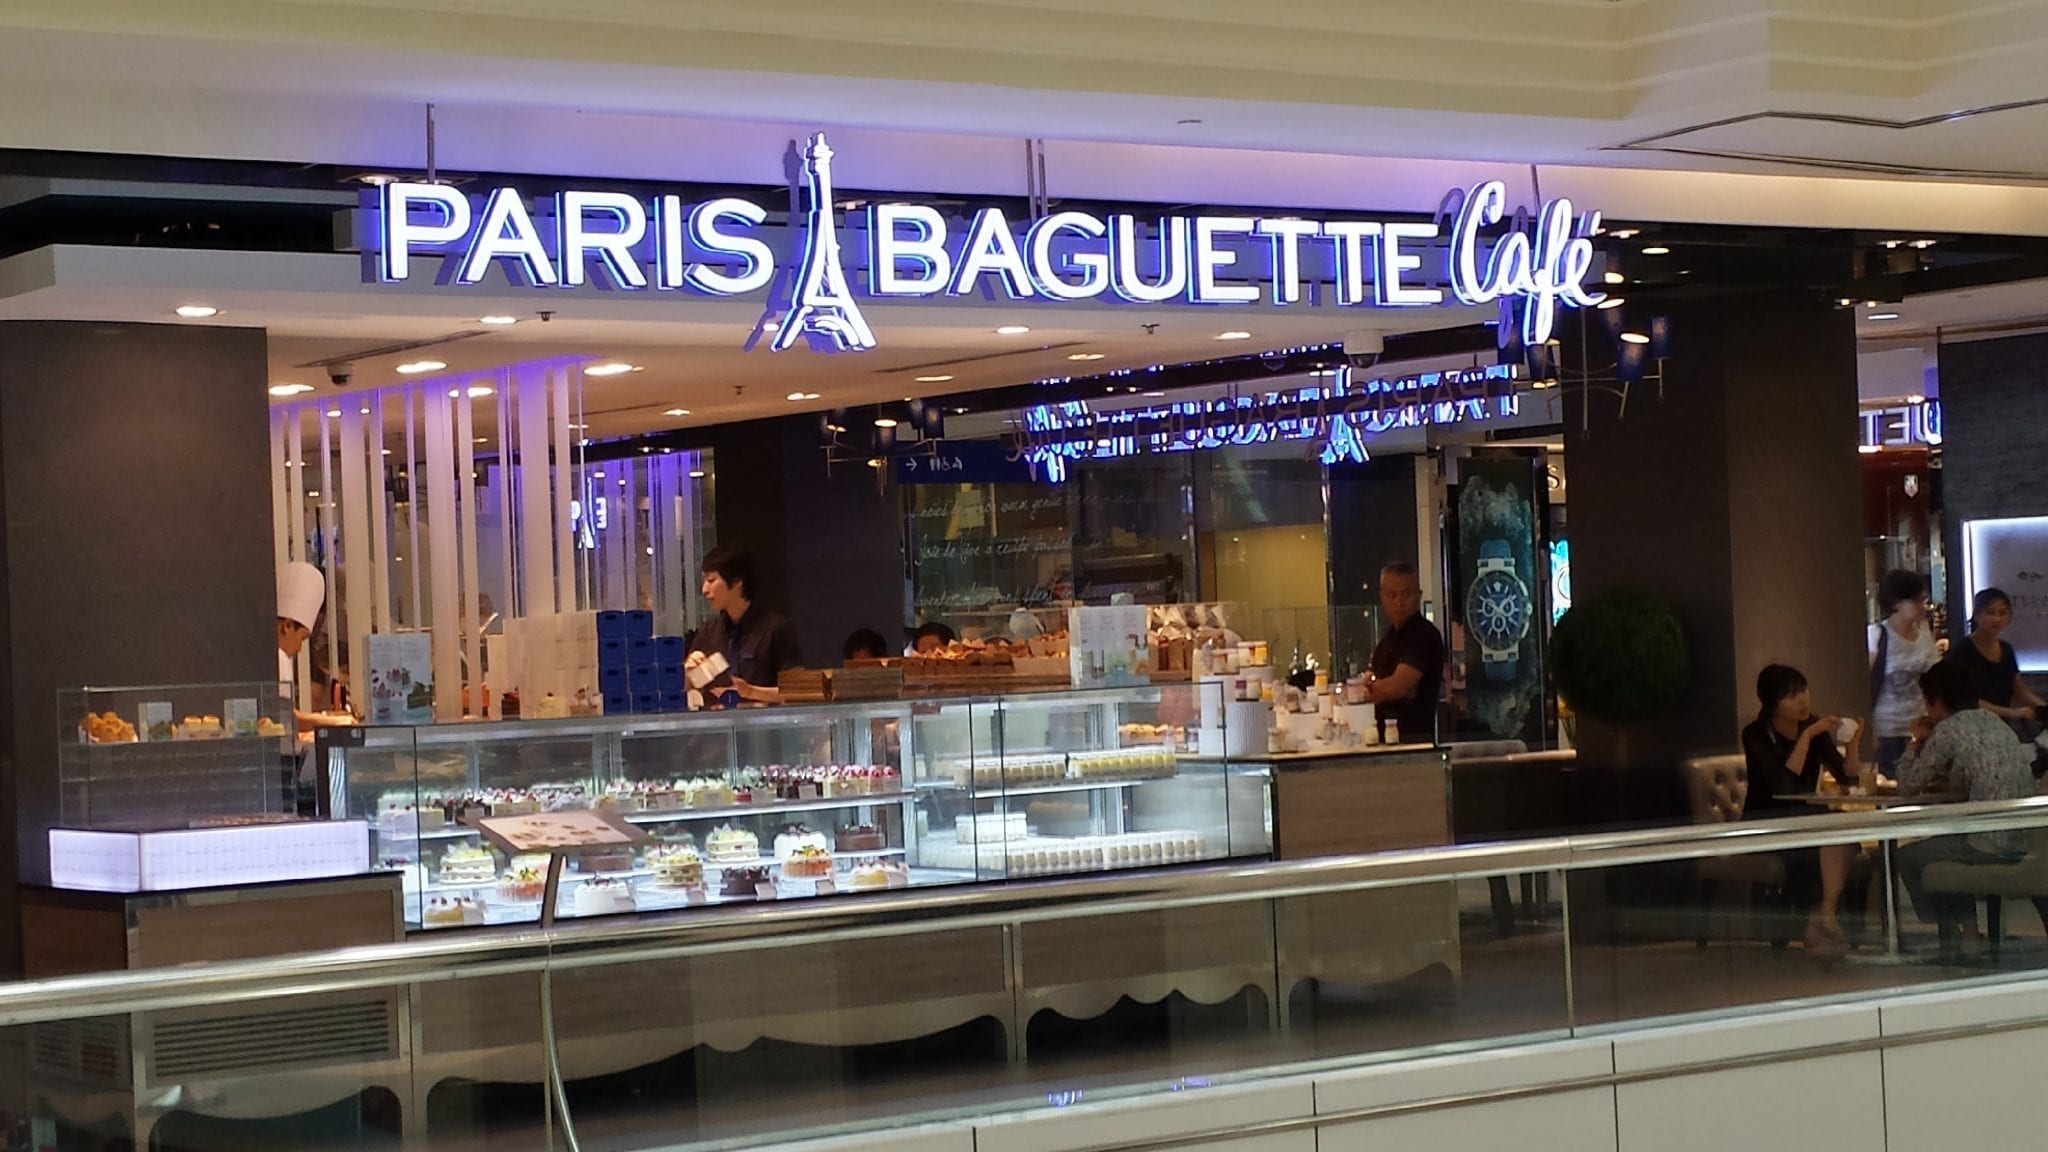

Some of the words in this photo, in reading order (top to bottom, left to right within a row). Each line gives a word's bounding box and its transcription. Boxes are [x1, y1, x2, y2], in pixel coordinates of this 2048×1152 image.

[381, 182, 775, 296] PARIS
[869, 204, 1443, 306] BAGUETTE
[1451, 180, 1607, 346] Café
